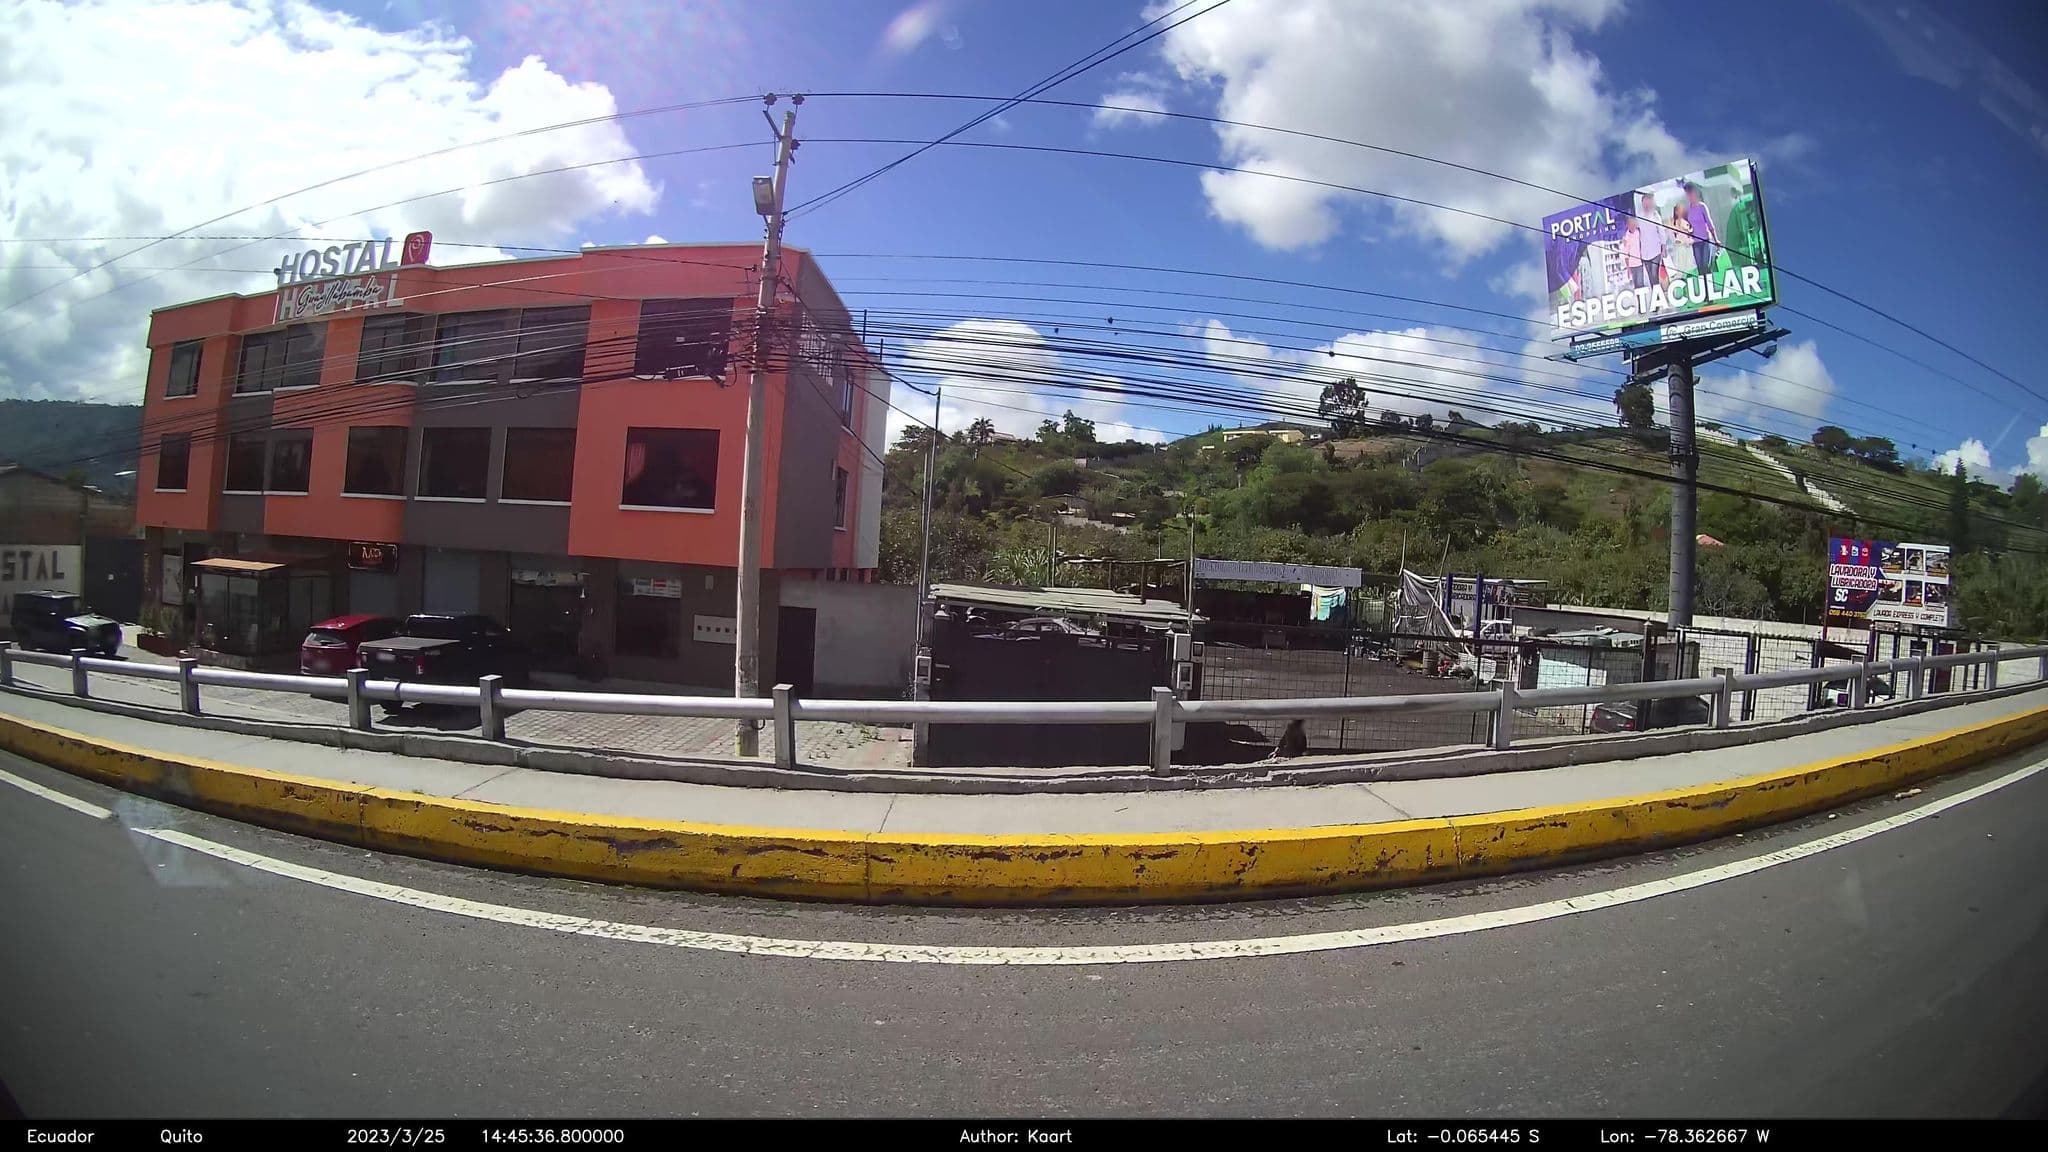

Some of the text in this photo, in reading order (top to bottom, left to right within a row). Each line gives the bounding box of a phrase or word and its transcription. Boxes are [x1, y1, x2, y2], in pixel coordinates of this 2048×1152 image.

[1551, 207, 1615, 241] PORTAL
[277, 236, 398, 285] HOSTAL
[1557, 265, 1762, 330] ESPECTACULAR
[1685, 320, 1709, 337] Gran
[1830, 564, 1868, 578] LAVADORA
[1870, 566, 1876, 578] Y
[1832, 577, 1877, 589] LUBRICADORA
[1834, 588, 1849, 602] SC
[1893, 610, 1915, 619] EXPRESS
